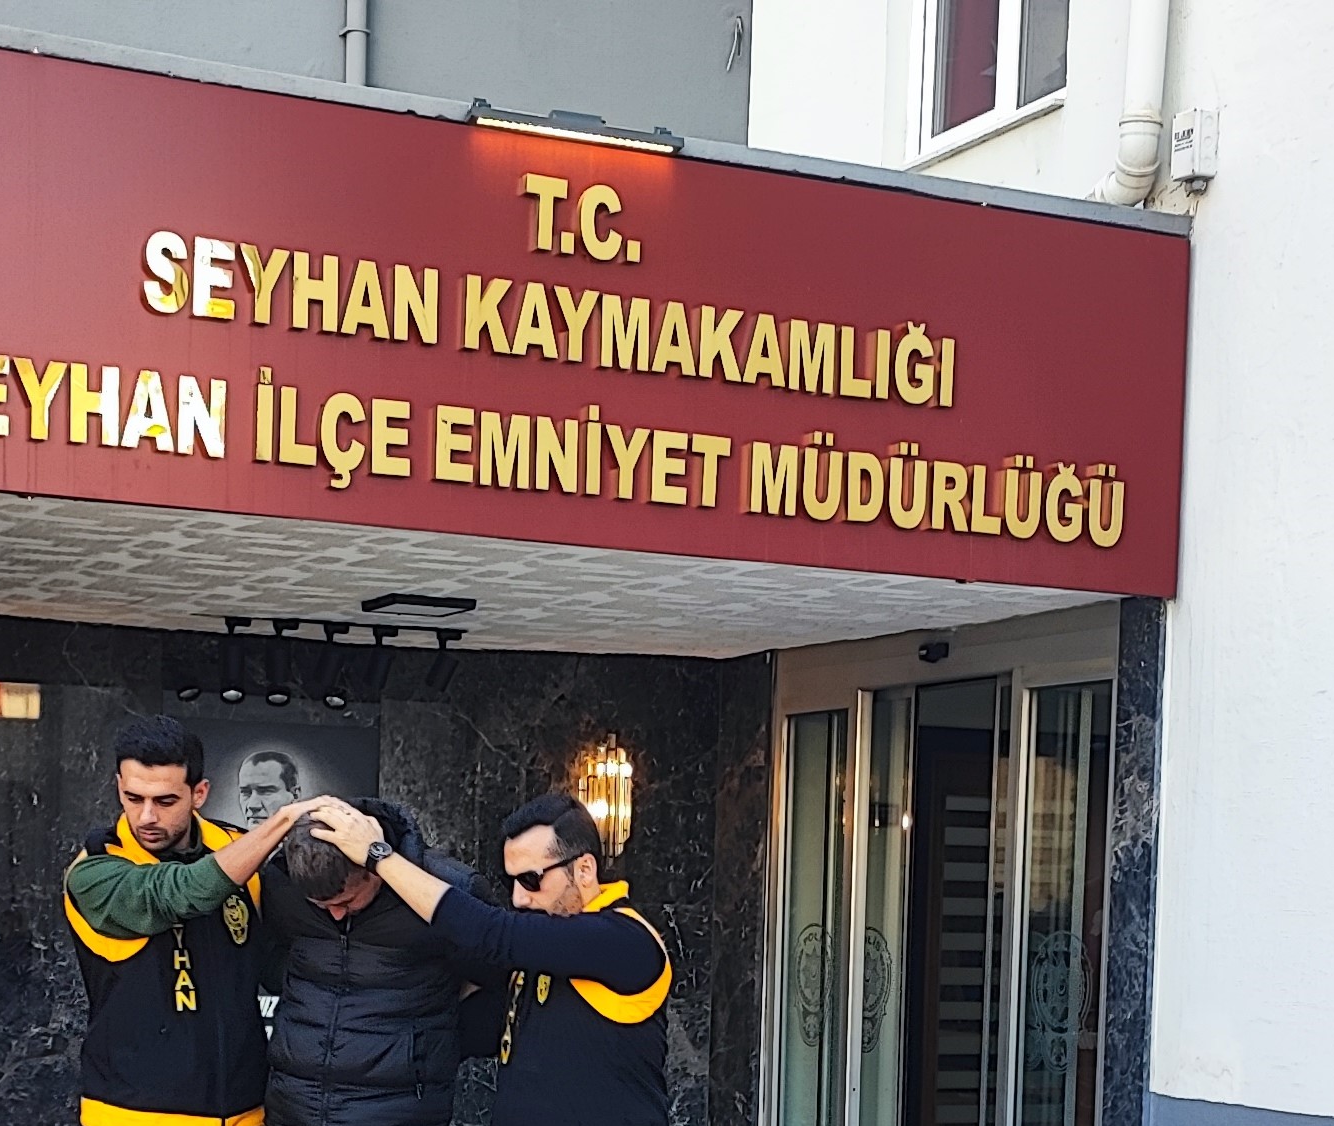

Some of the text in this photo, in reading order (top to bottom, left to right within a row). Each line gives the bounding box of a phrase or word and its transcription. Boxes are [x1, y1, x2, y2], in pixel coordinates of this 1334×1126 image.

[524, 173, 642, 263] T.C.
[142, 230, 957, 408] SEYHAN KAYMAKAMLIĞI
[254, 366, 411, 488] İLÇE
[434, 404, 732, 508] EMNİYET
[750, 430, 1126, 549] MÜDÜRLÜĞÜ
[172, 923, 197, 1012] YHAN
